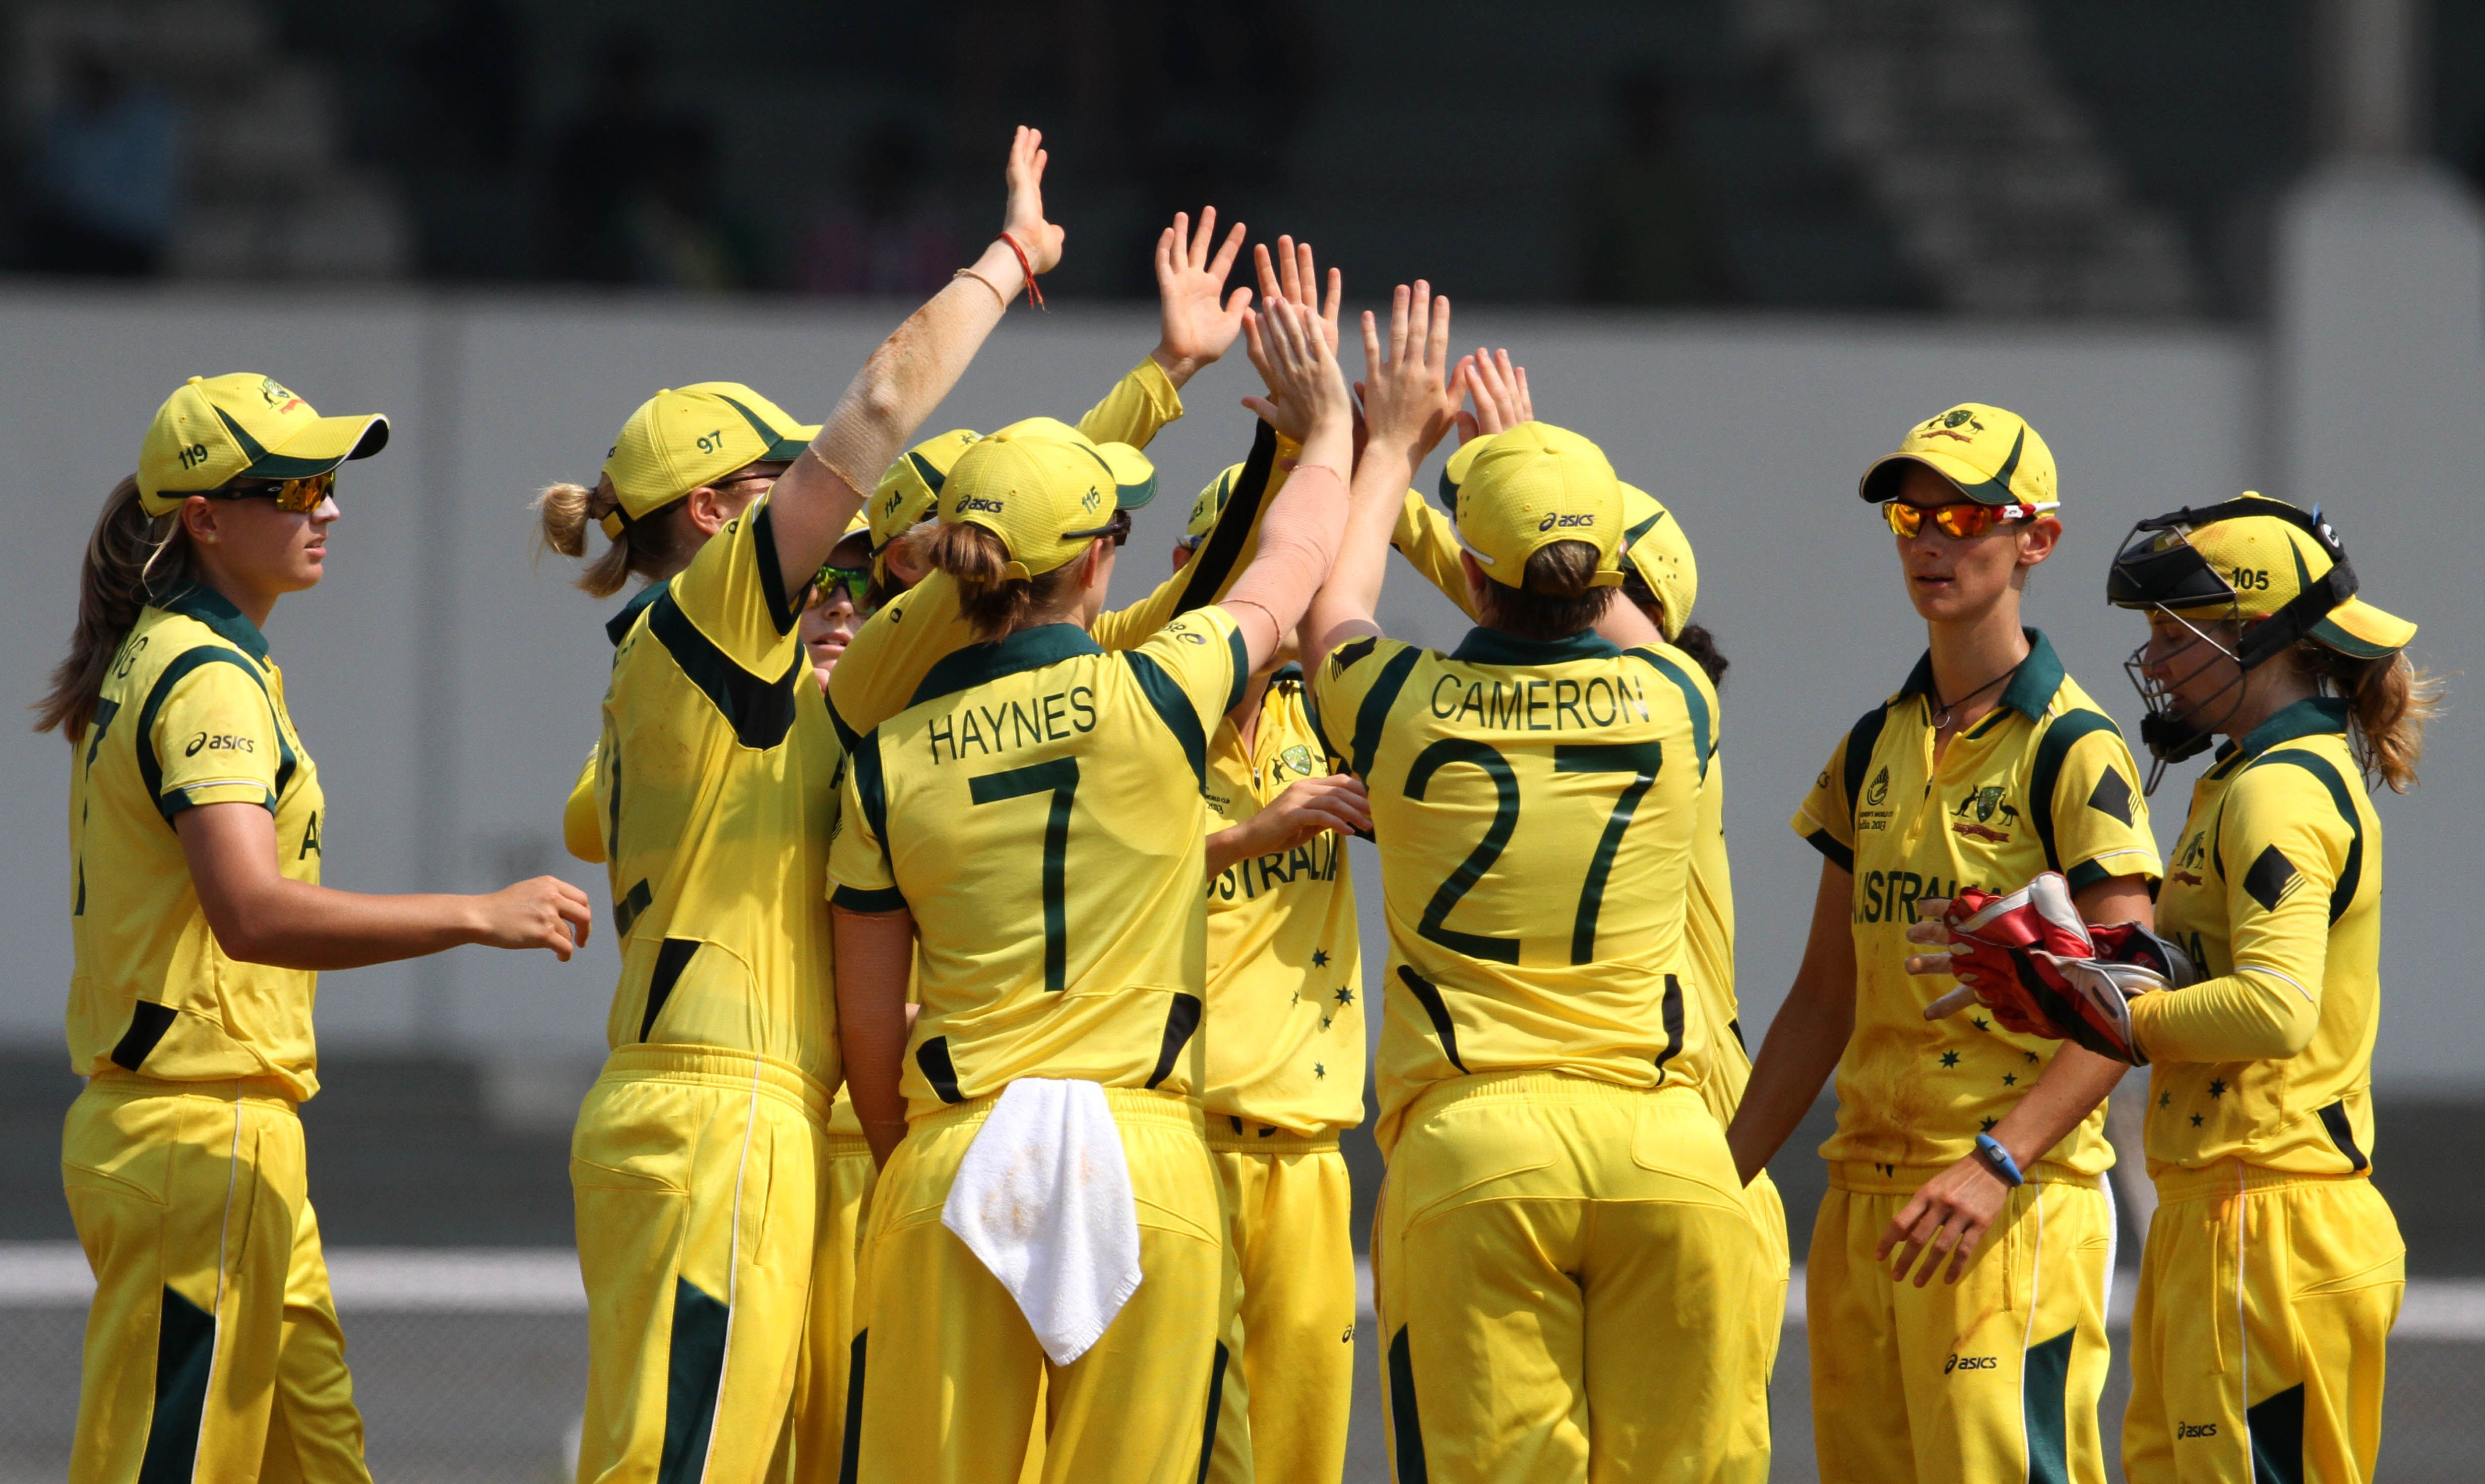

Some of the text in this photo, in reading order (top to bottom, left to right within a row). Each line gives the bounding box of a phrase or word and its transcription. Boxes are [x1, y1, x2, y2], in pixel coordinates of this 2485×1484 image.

[697, 430, 723, 455] 97
[178, 443, 208, 470] 119
[885, 489, 903, 519] 114
[968, 498, 1004, 513] asics
[1082, 484, 1101, 515] 115
[1558, 513, 1594, 527] asics
[2232, 567, 2269, 591] 105
[1431, 673, 1650, 731] CAMERON
[928, 686, 1097, 765] HAYNES
[208, 735, 255, 753] asics
[1403, 738, 1663, 965] 27
[968, 756, 1080, 992] 7
[1958, 1356, 1997, 1370] asics
[2185, 1422, 2217, 1438] asics
